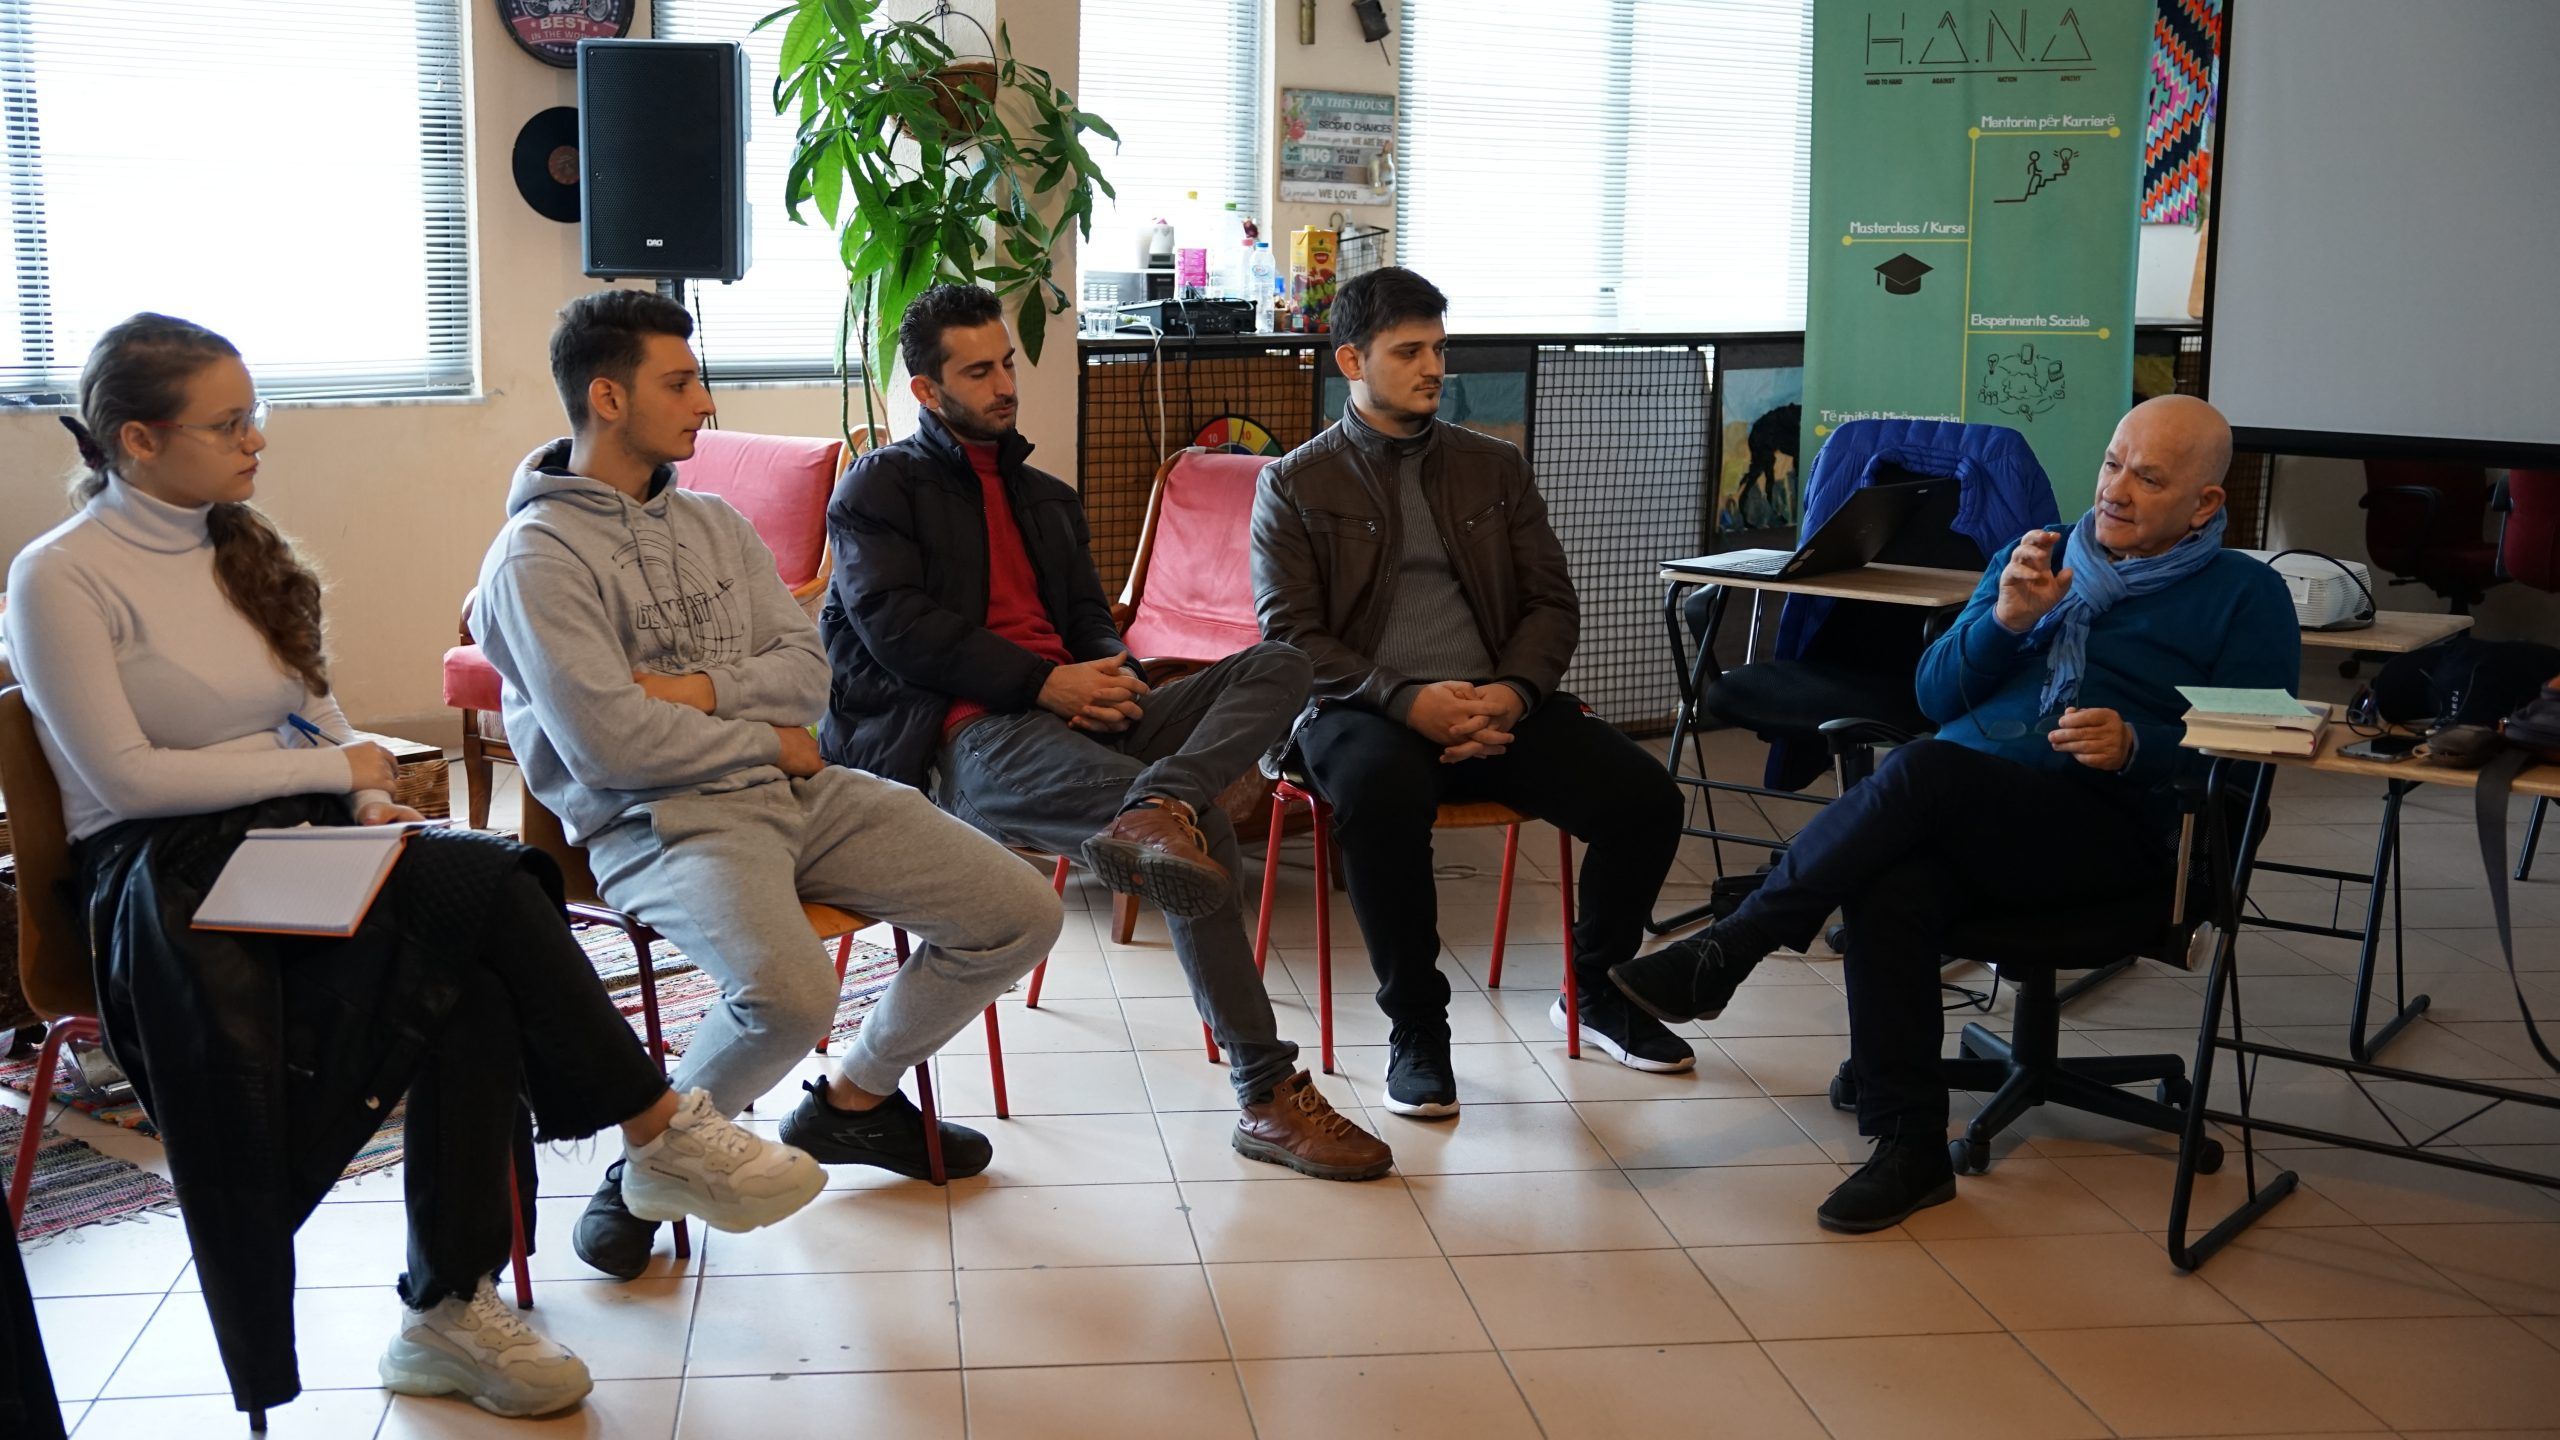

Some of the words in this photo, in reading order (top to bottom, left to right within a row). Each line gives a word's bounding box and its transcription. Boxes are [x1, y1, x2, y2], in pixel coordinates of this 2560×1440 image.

[541, 16, 589, 31] BEST
[545, 31, 561, 39] THE
[1311, 96, 1325, 107] IN
[1327, 97, 1352, 109] THIS
[1353, 99, 1391, 111] HOUSE
[1318, 120, 1352, 131] SECOND
[1353, 122, 1393, 133] CHANCES
[2038, 114, 2061, 130] për
[2062, 113, 2116, 127] Karrierë
[1301, 148, 1331, 163] HUG
[1338, 155, 1359, 165] FUN
[1319, 189, 1333, 199] WE
[1334, 190, 1358, 200] LOVE
[1850, 221, 1919, 234] Masterclass
[1930, 221, 1965, 234] Kurse
[1971, 313, 2047, 329] Eksperimente
[2049, 314, 2091, 327] Sociale
[1820, 410, 1837, 422] Të
[1207, 433, 1218, 444] 10
